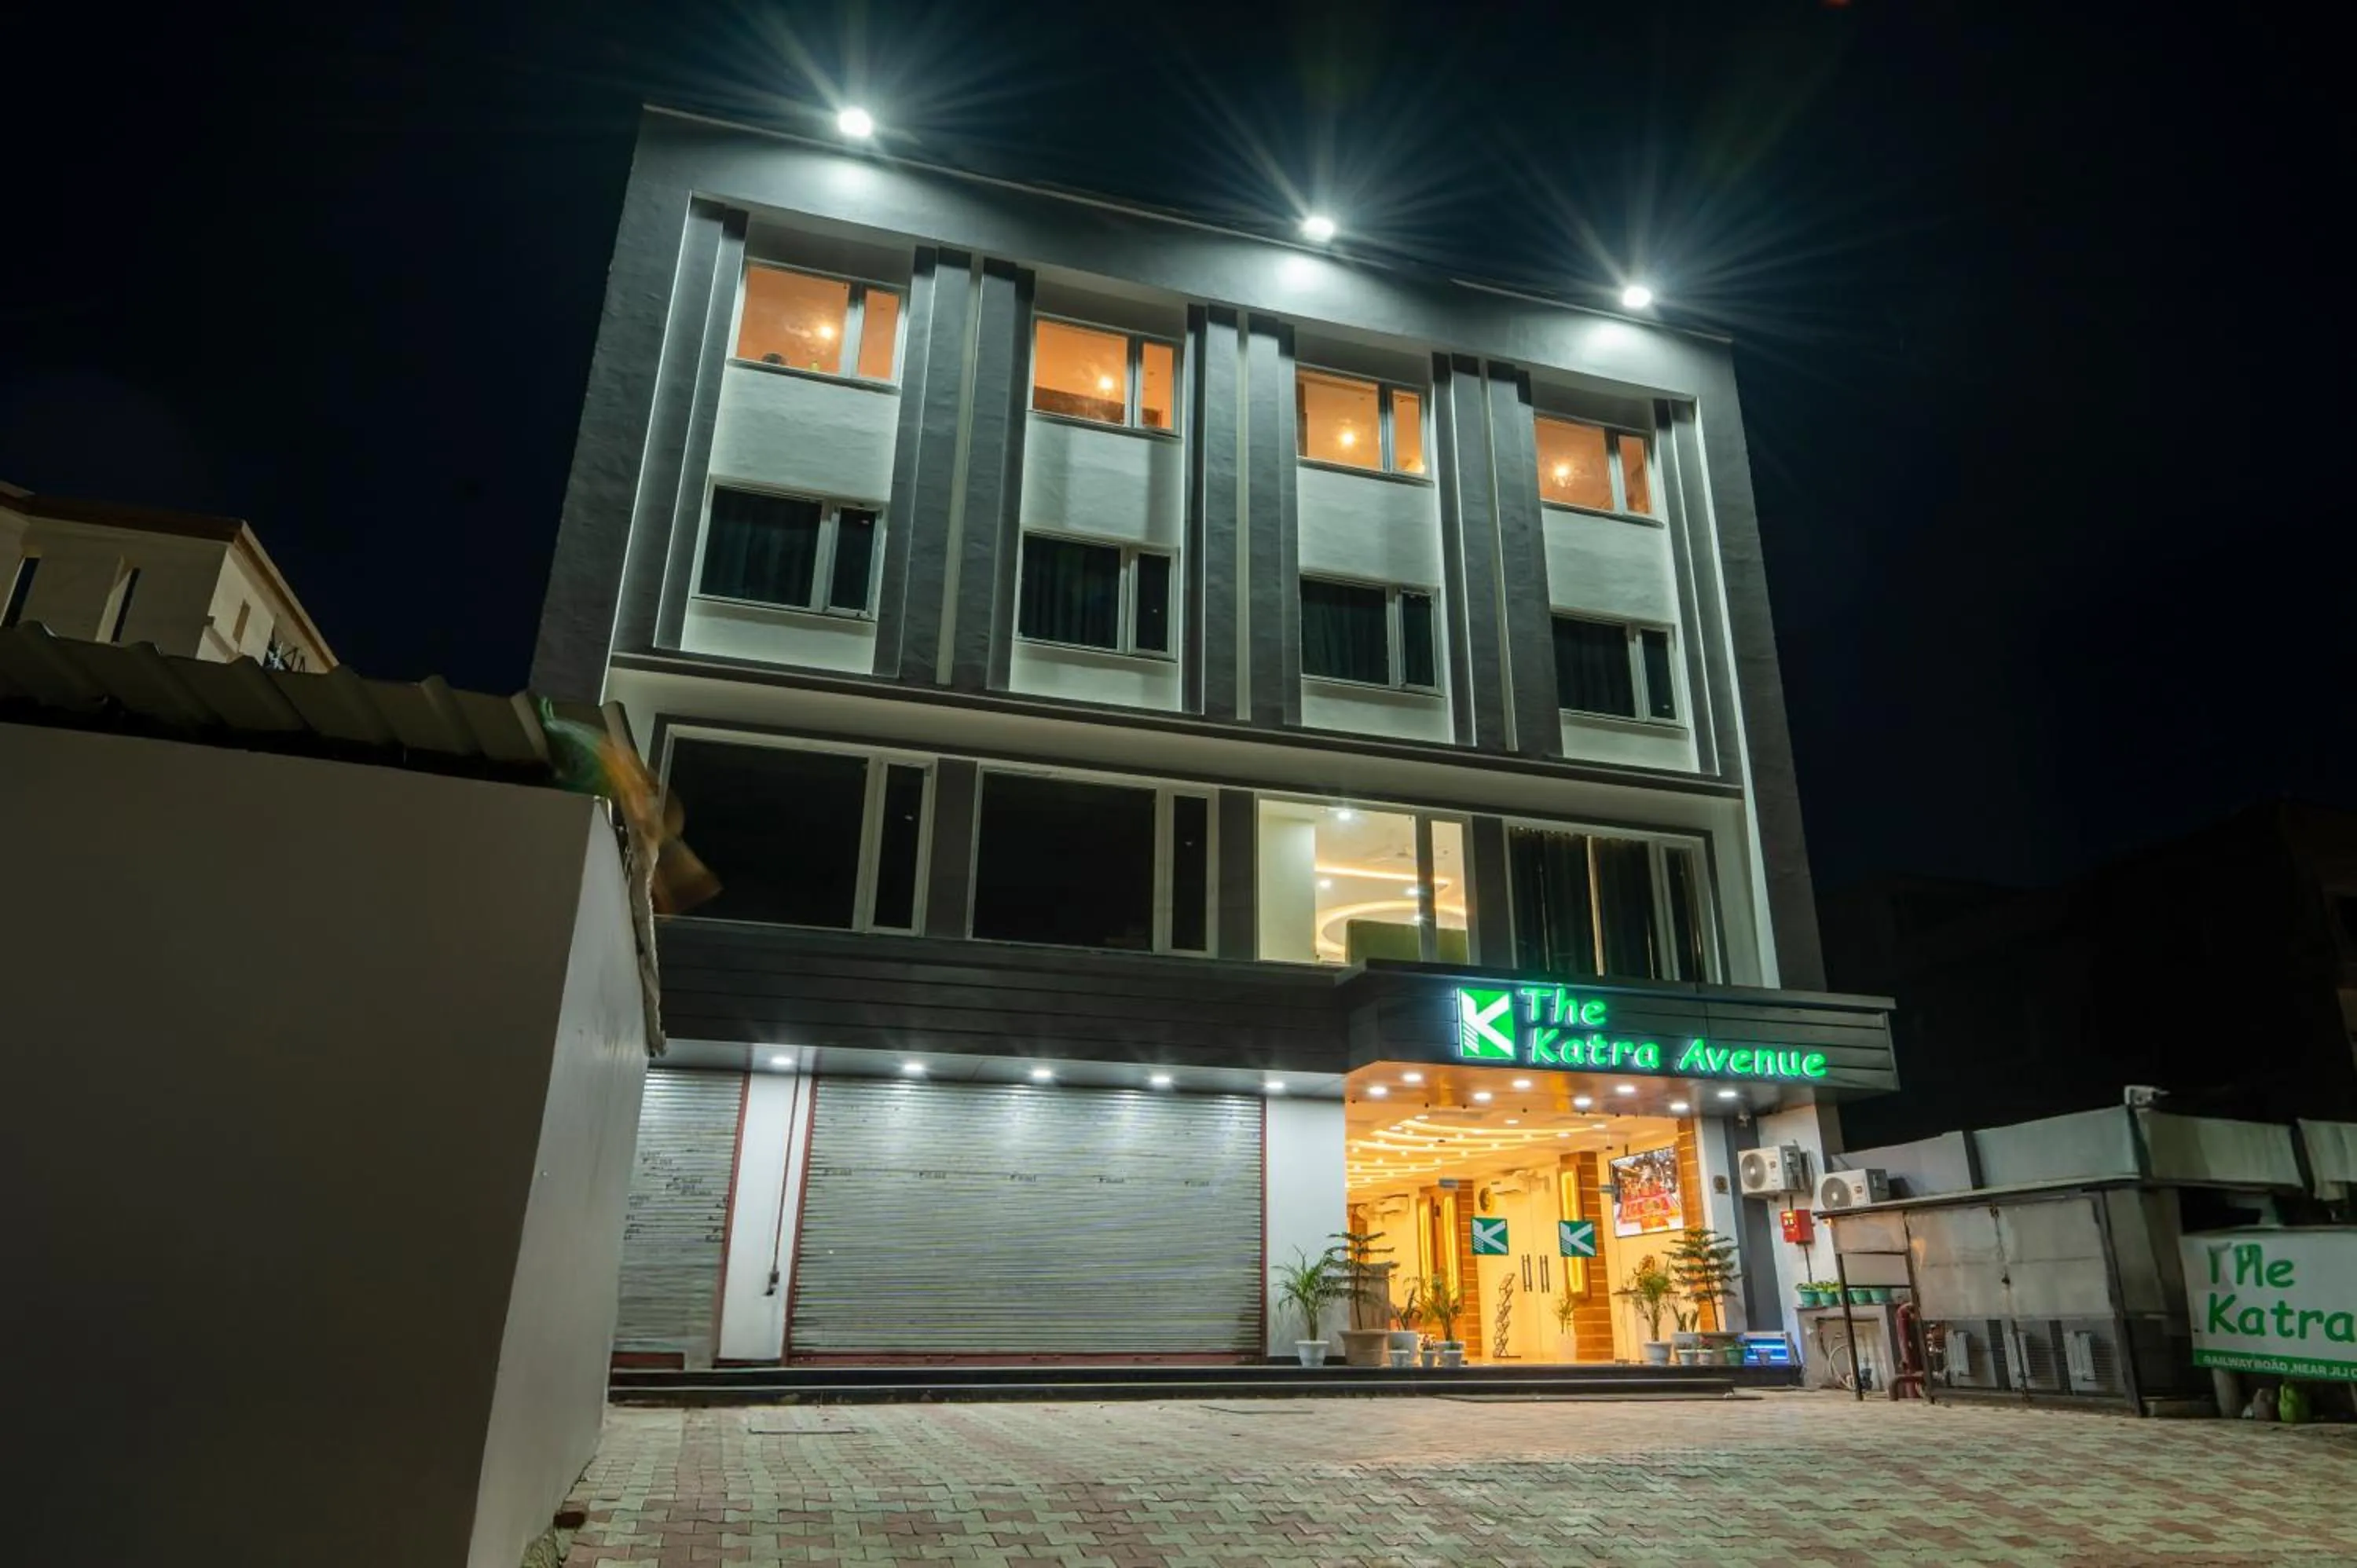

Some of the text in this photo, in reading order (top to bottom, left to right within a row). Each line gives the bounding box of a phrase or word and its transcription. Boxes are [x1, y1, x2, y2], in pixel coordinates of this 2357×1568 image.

[1521, 984, 1607, 1025] The
[1530, 1027, 1827, 1078] Katra Avenue
[2208, 1292, 2355, 1343] Katra
